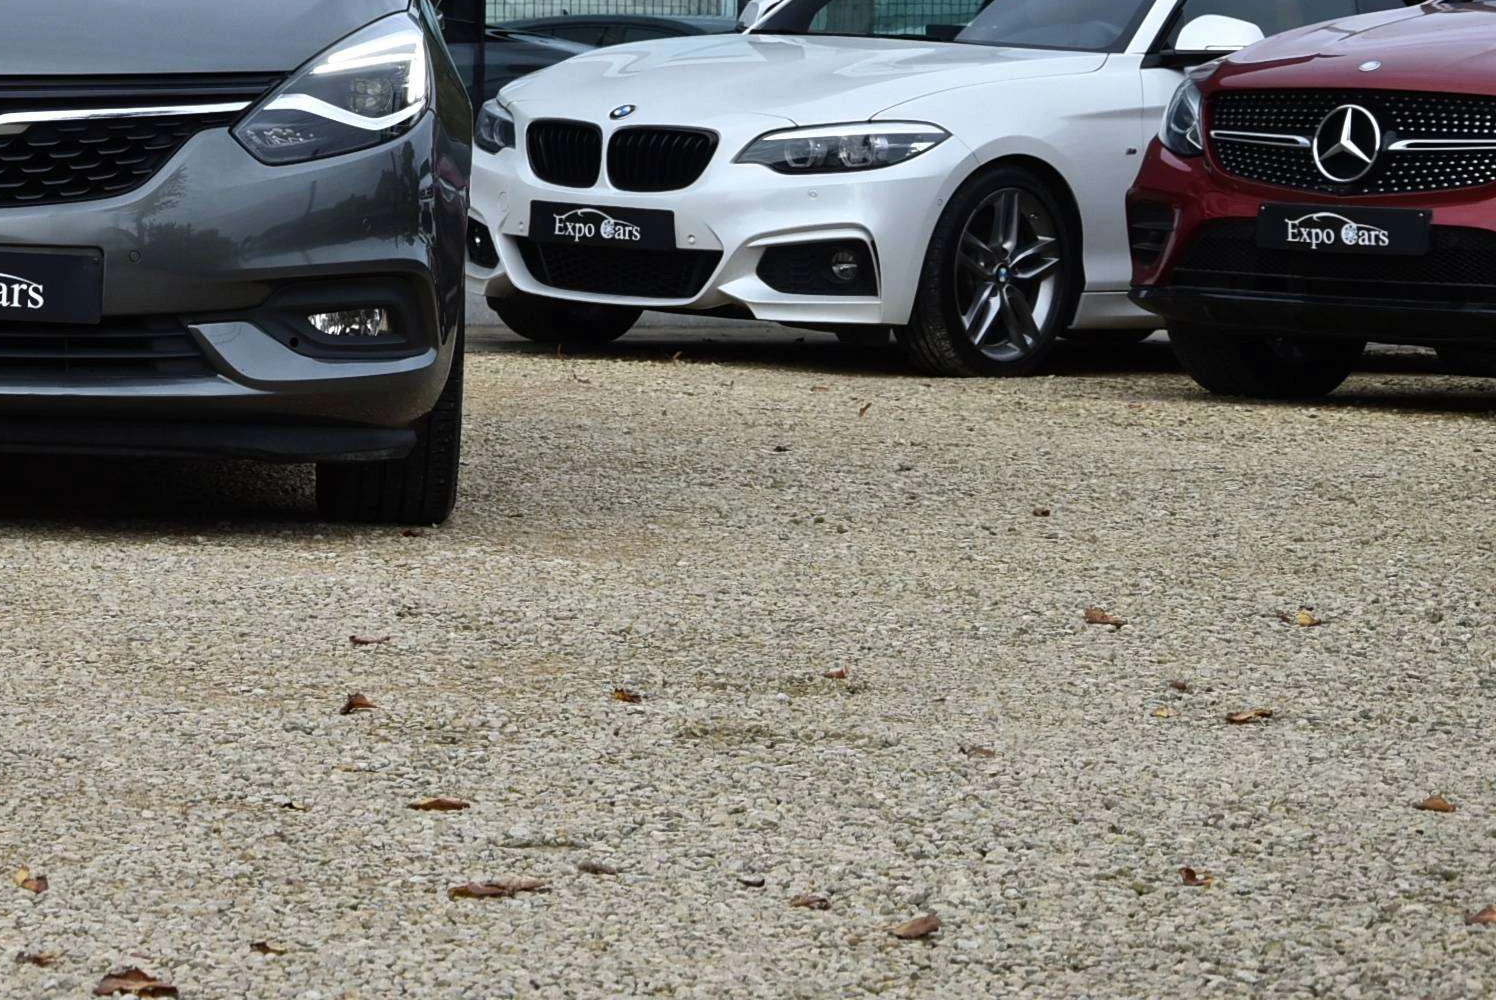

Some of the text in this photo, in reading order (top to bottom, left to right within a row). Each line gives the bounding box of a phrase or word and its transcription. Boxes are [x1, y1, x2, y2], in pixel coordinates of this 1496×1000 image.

[554, 214, 641, 242] Expo Cars
[1285, 220, 1389, 249] Expo Cars
